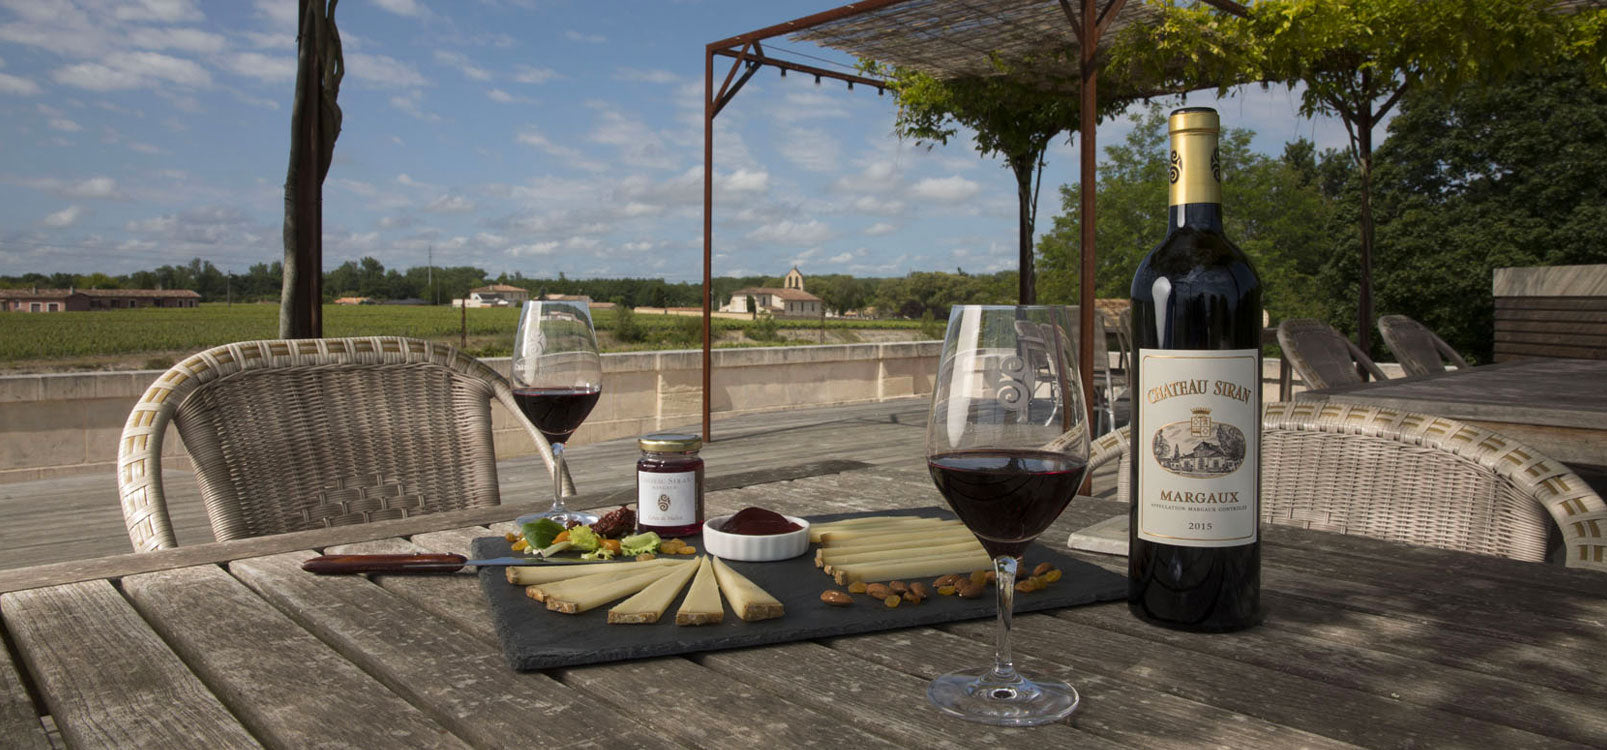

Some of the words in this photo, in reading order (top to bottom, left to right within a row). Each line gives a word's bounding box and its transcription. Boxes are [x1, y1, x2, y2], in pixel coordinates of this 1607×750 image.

[1147, 379, 1208, 404] CHATEAU
[1213, 380, 1252, 404] SIRAN
[1160, 490, 1240, 504] MARGAUX
[1188, 522, 1213, 530] 2015
